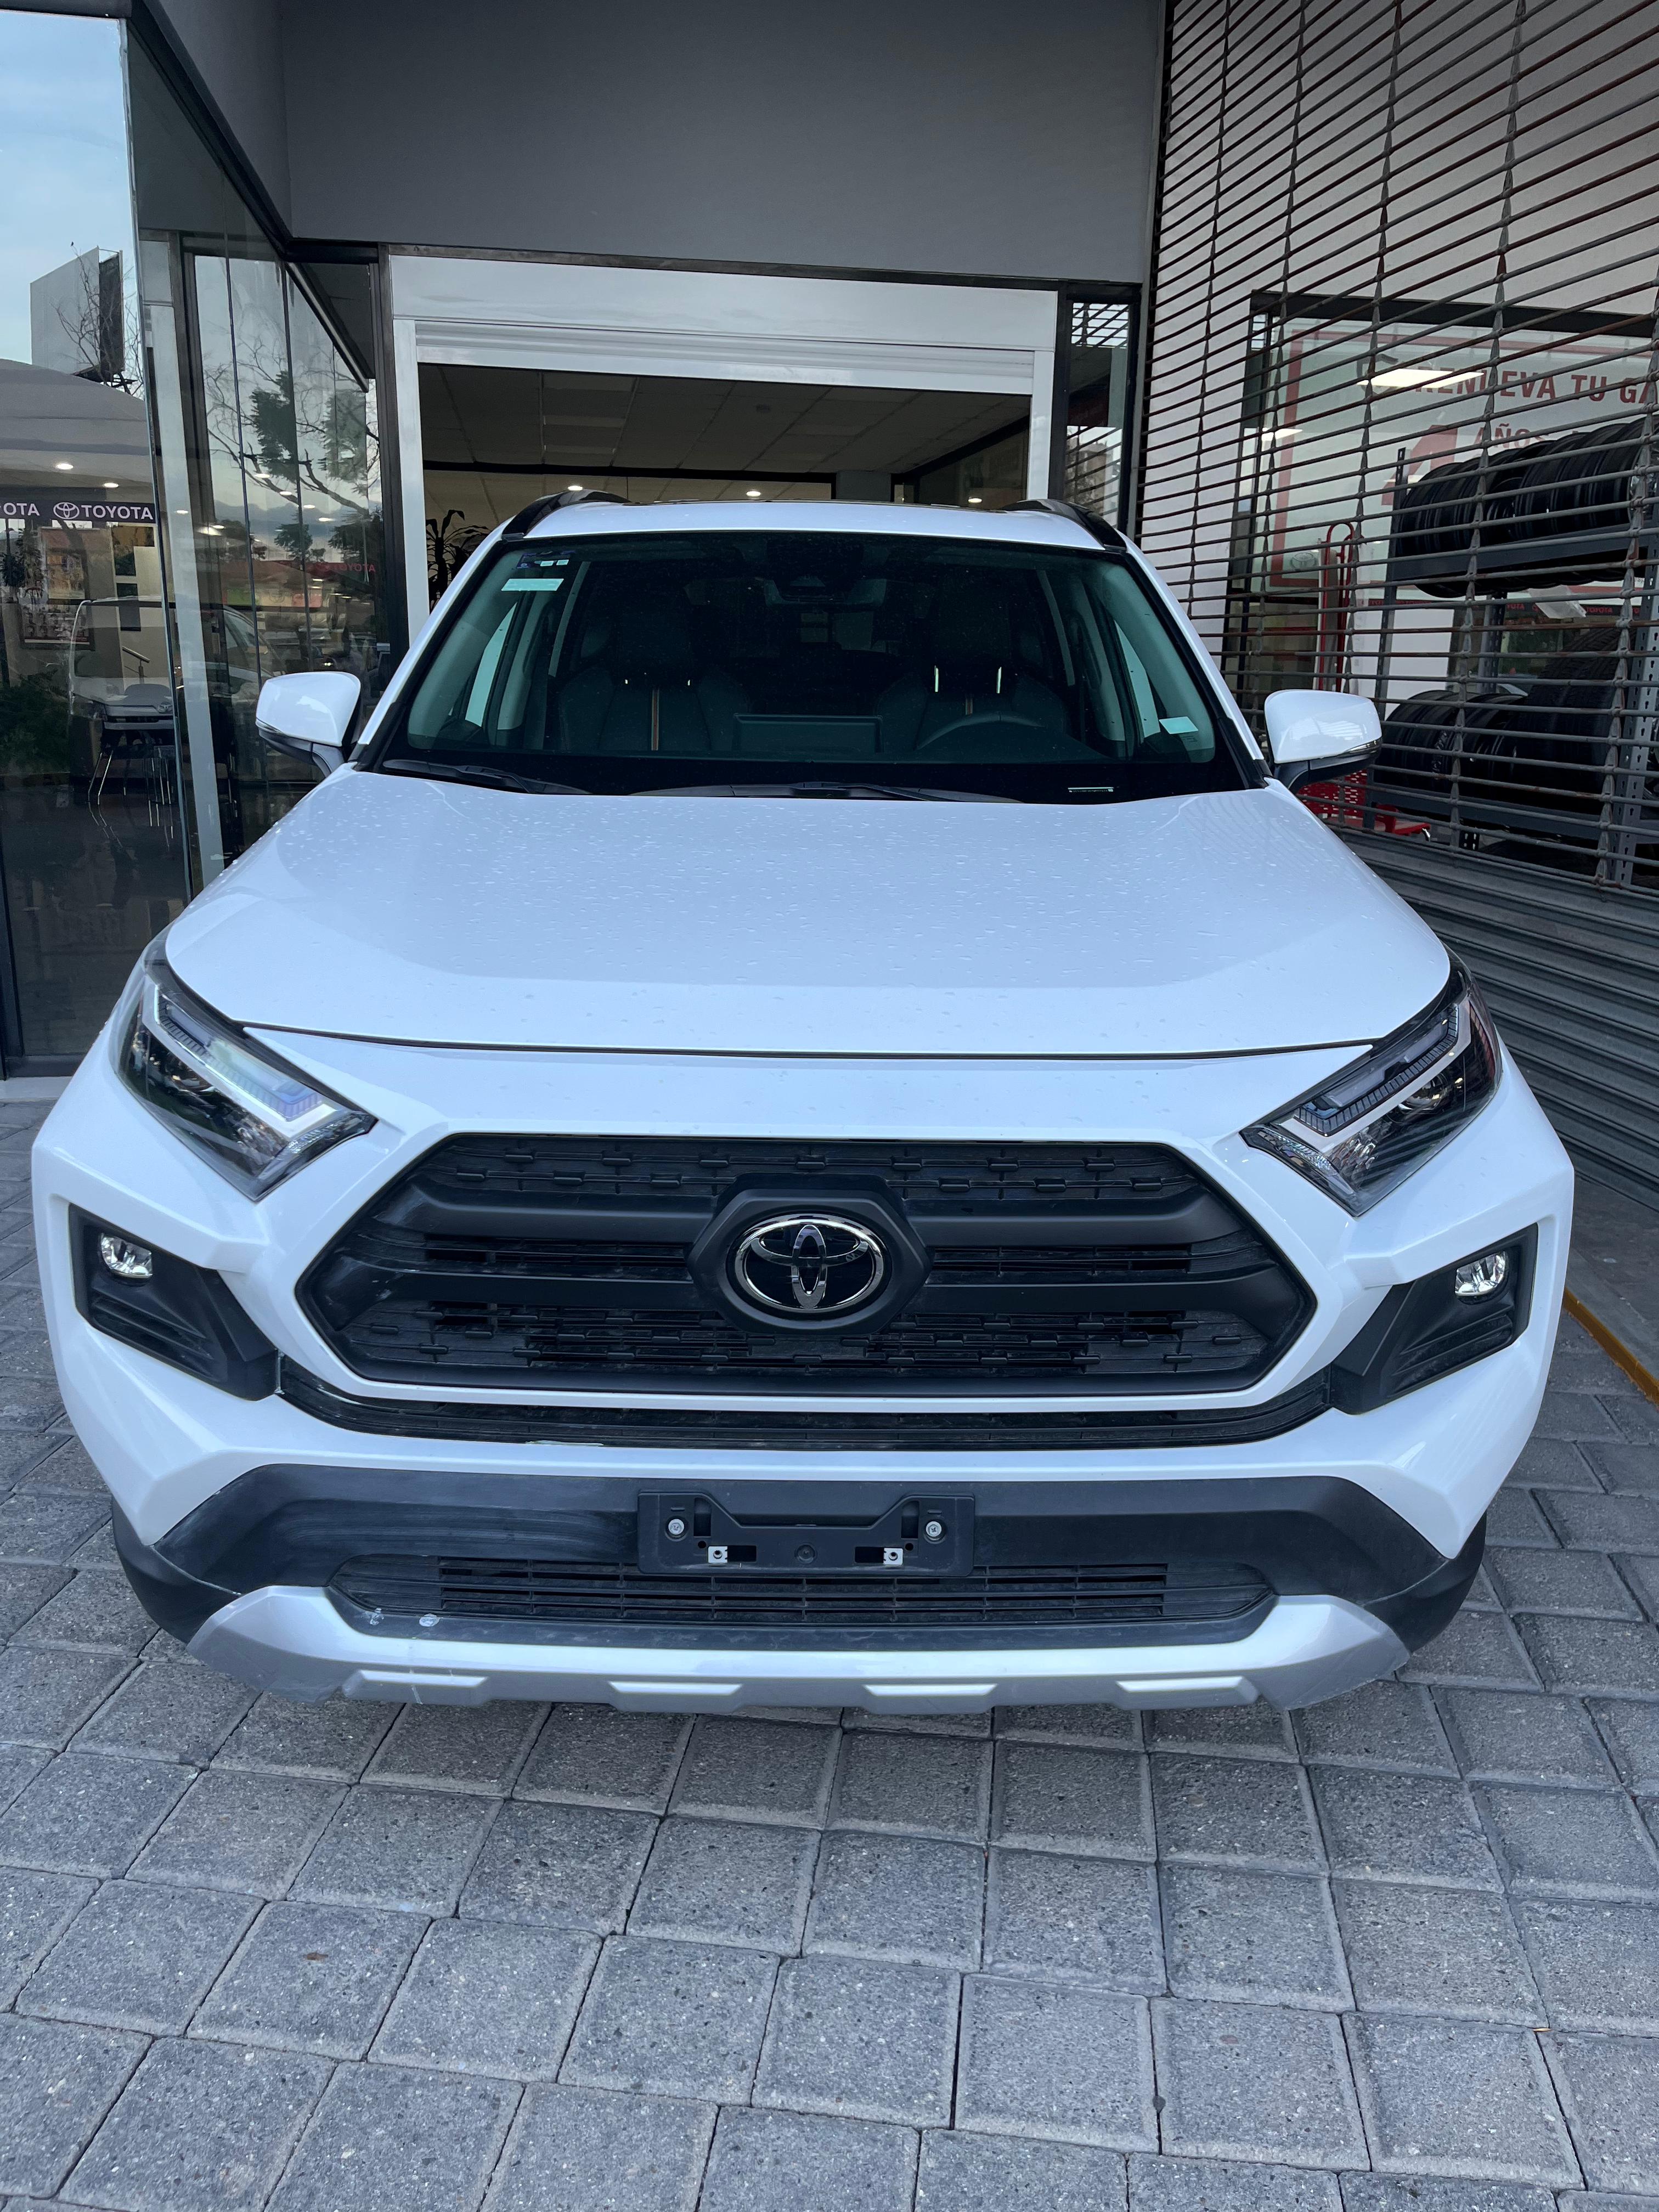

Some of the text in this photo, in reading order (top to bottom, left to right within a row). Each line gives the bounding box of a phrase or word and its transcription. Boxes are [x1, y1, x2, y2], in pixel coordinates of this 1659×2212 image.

[1571, 374, 1607, 402] TU
[0, 502, 154, 520] OTA TOYOTA
